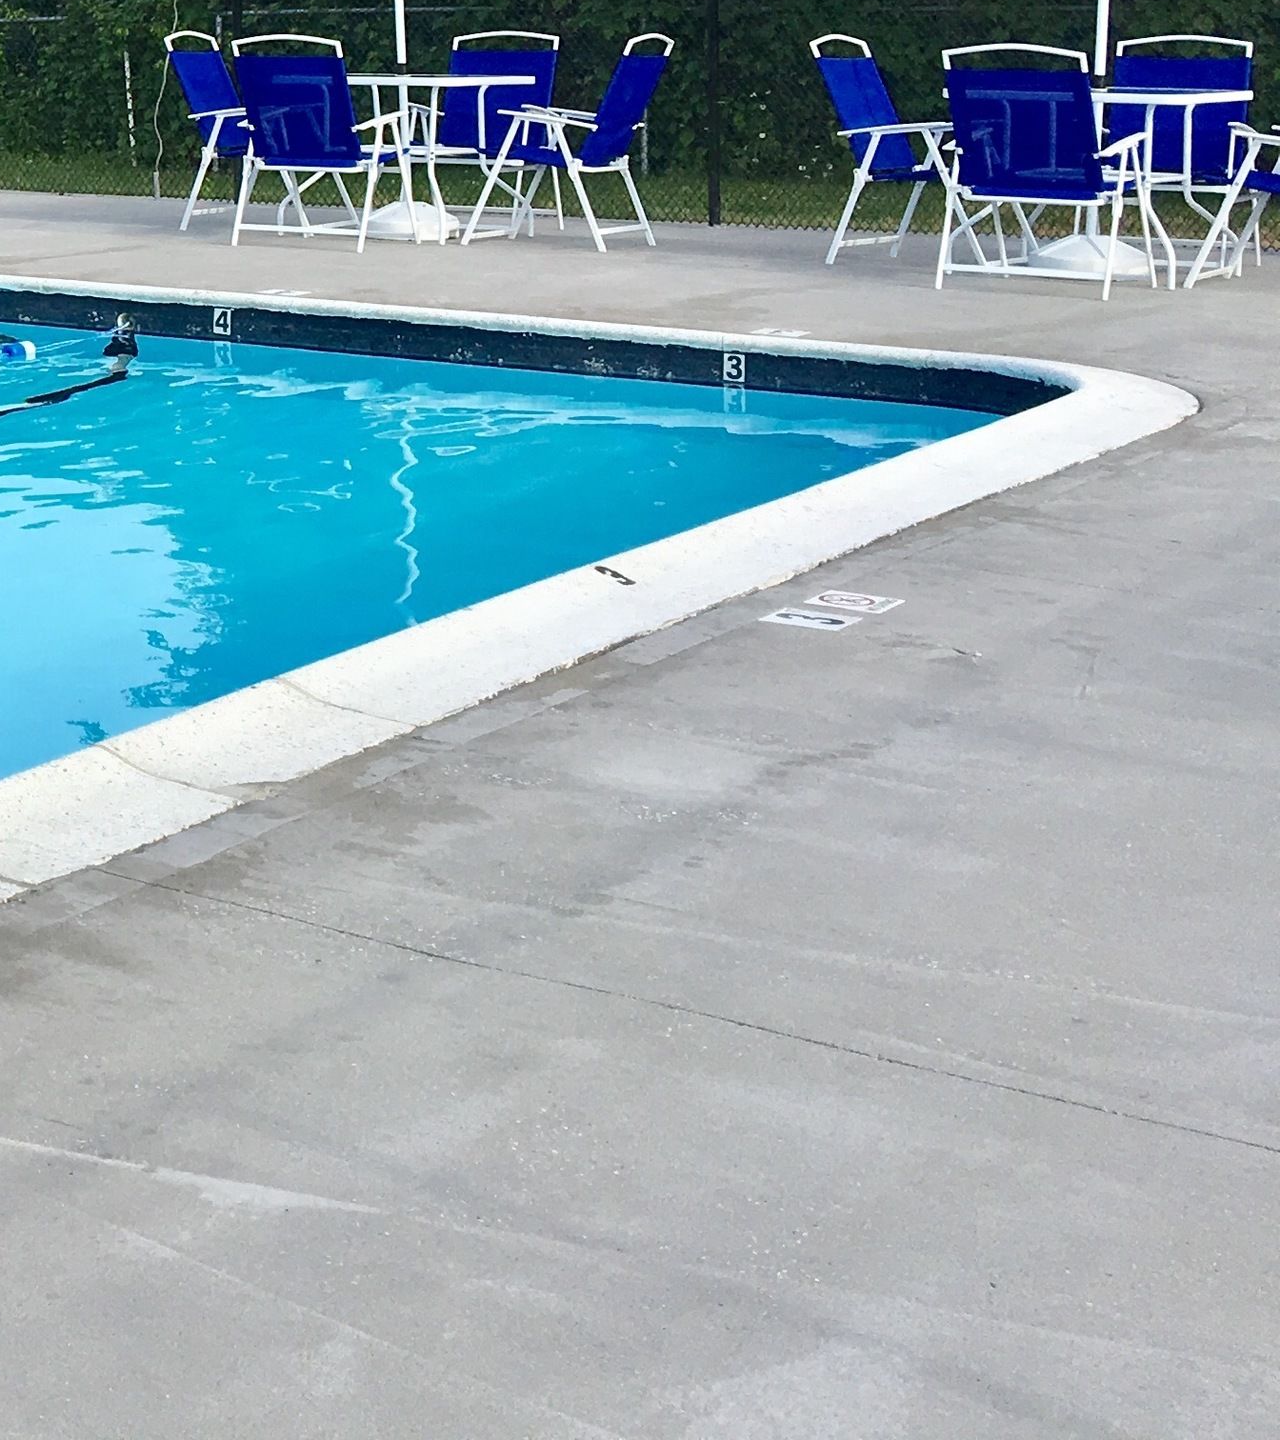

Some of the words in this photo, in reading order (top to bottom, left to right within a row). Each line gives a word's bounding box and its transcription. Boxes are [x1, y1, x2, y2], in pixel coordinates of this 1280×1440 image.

[214, 310, 229, 333] 4
[726, 355, 743, 380] 3
[593, 565, 637, 586] 3
[775, 612, 846, 626] 3
